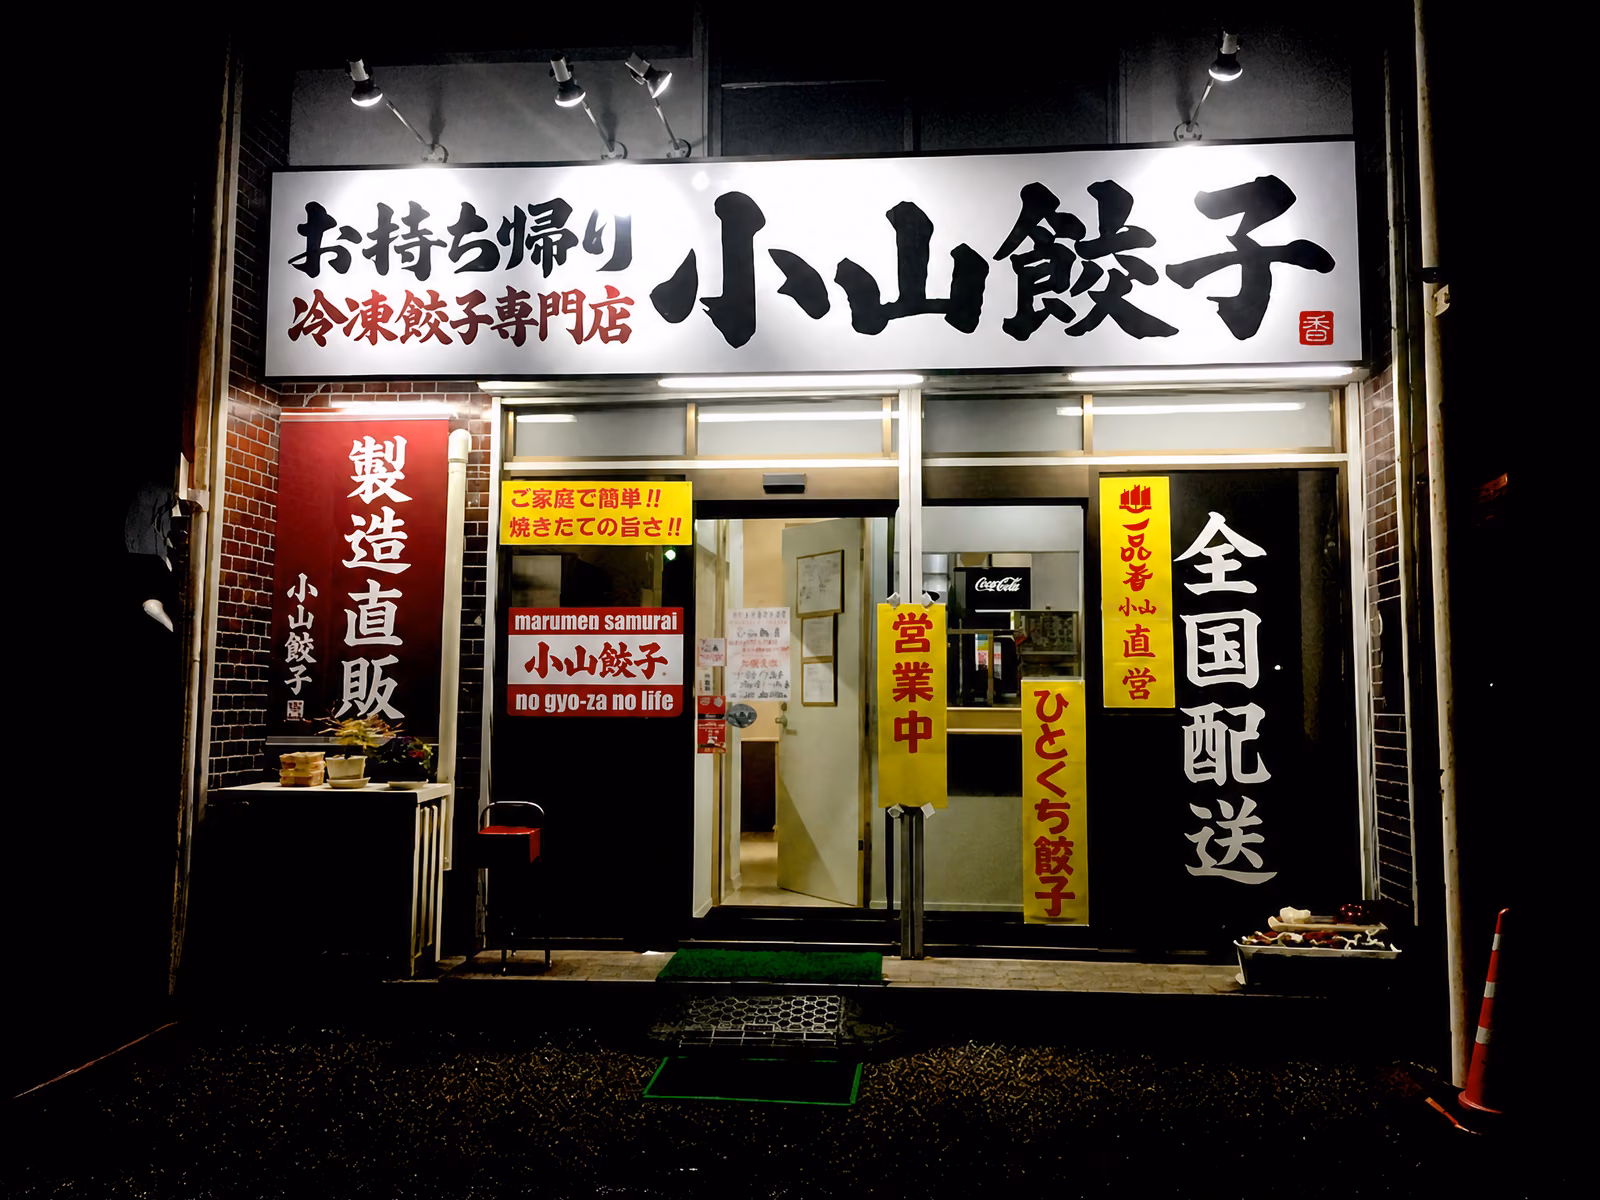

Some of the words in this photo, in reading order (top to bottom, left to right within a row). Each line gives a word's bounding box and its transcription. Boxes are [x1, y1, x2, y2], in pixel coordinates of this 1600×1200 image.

[287, 198, 632, 281] お持ち帰り
[649, 175, 1335, 349] 小山餃子
[287, 285, 635, 347] 冷凍餃子専門店
[1302, 314, 1331, 342] 香
[335, 435, 413, 720] 製造直販
[1118, 598, 1157, 617] 小山
[284, 573, 318, 696] 小山餃子
[514, 613, 599, 631] marumen
[604, 612, 677, 631] samurai
[524, 641, 669, 680] 小山餃子
[515, 693, 540, 711] no
[544, 693, 607, 713] gyo-za
[612, 693, 637, 711] no
[641, 690, 674, 711] life
[892, 612, 934, 754] 営業中
[1122, 623, 1156, 701] 直営
[1173, 511, 1278, 885] 全国配送
[1033, 690, 1076, 918] ひとくち餃子
